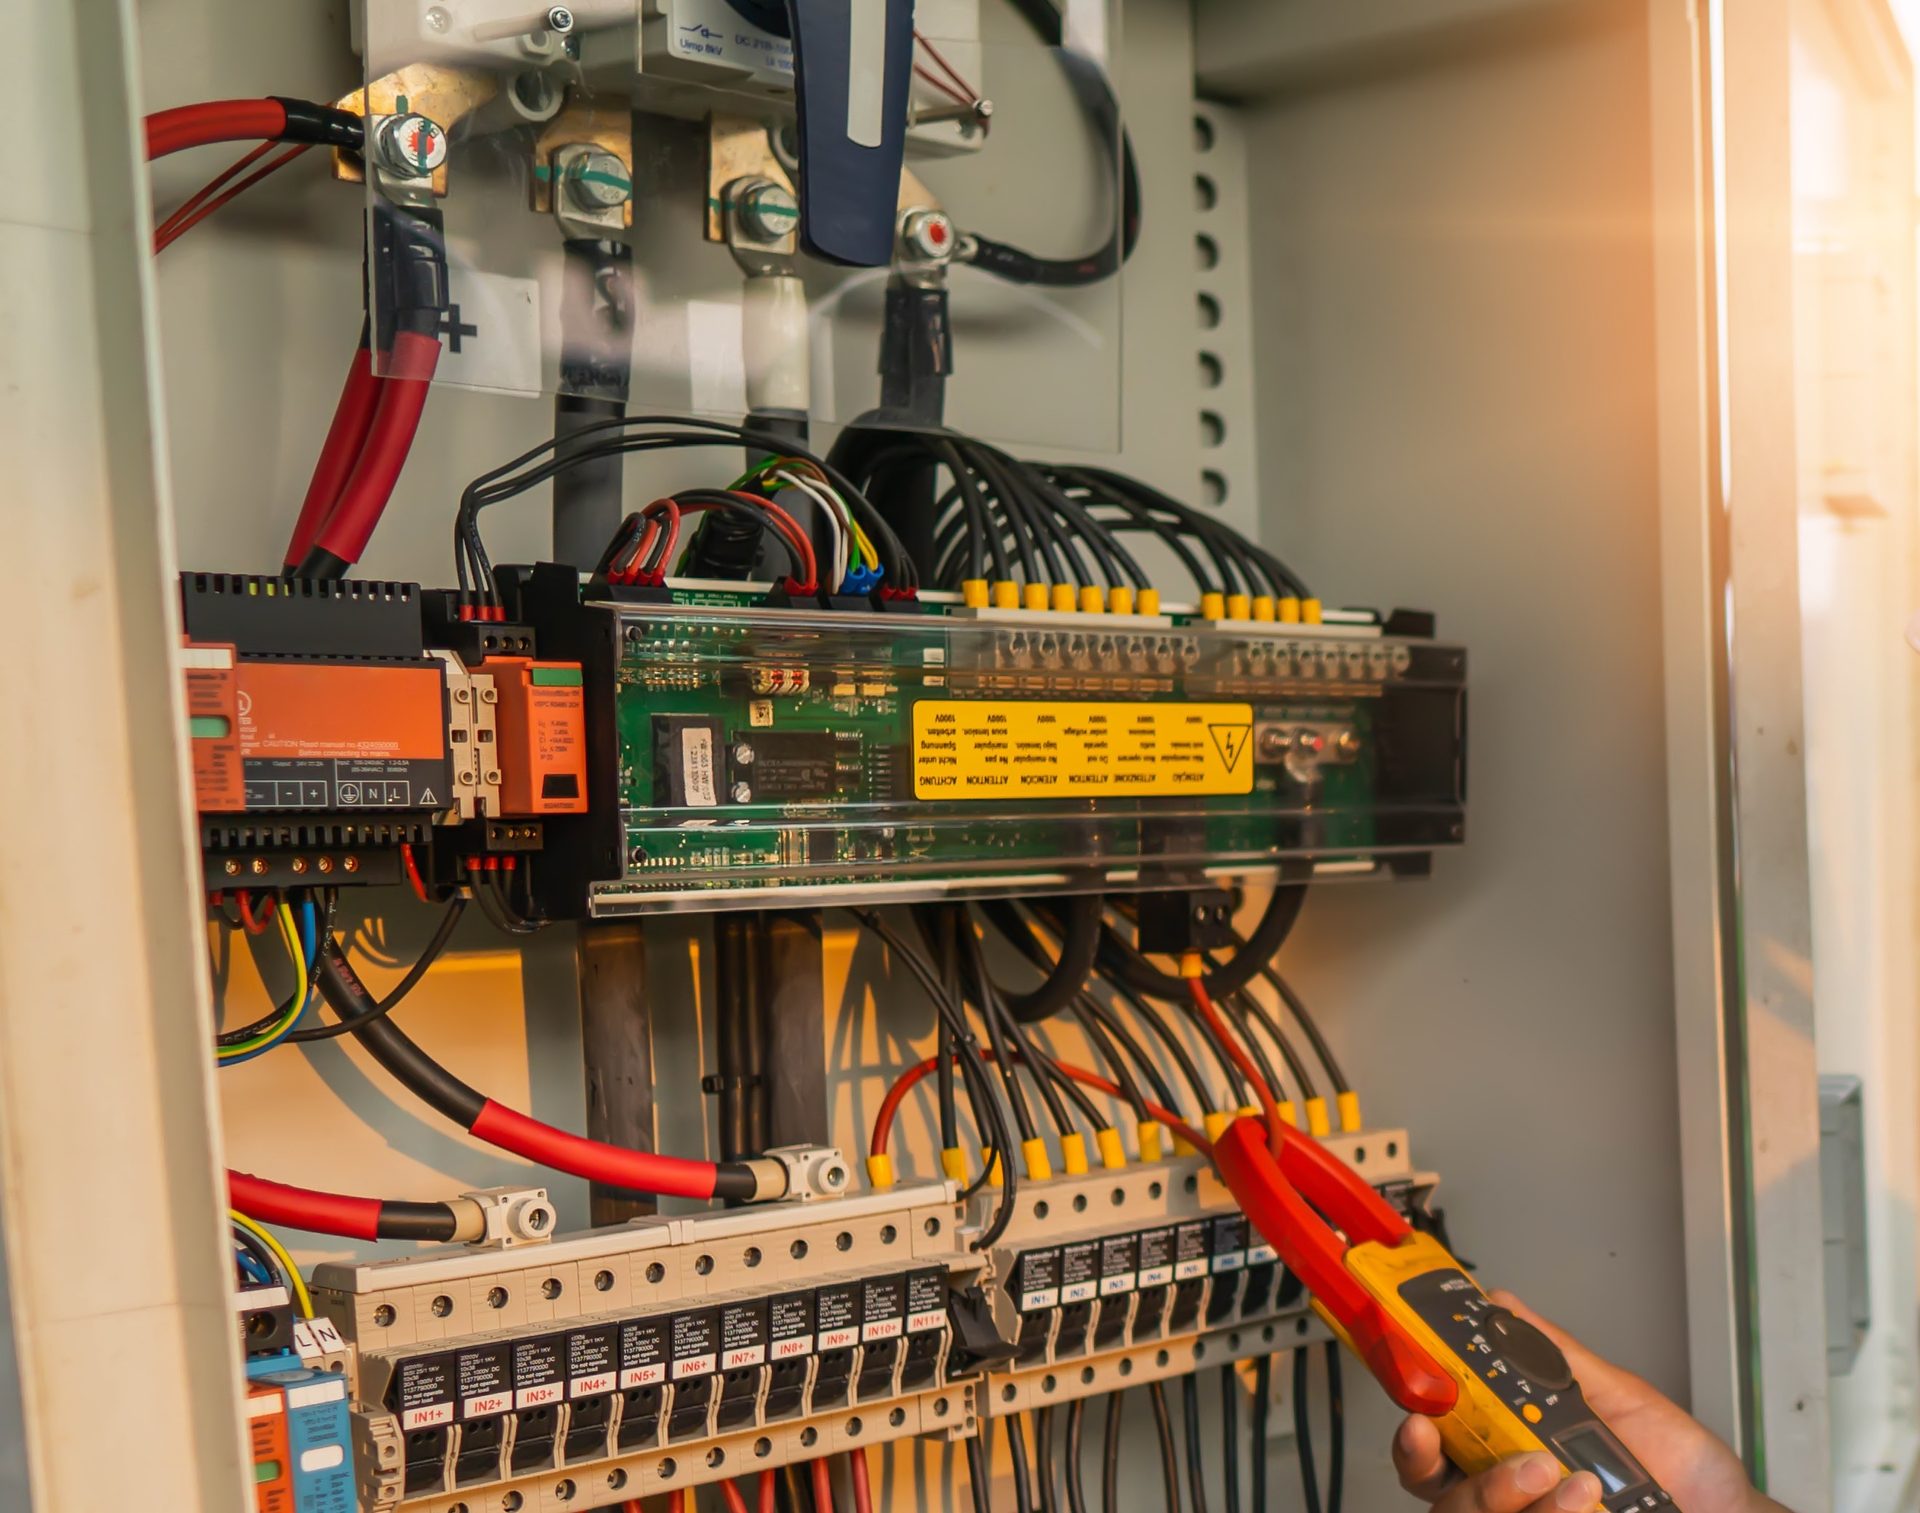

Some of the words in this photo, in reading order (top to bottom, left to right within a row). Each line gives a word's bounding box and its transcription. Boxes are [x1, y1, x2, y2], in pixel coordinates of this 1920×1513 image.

[935, 714, 955, 722] 1000V
[987, 714, 1006, 722] 1000V
[921, 741, 956, 750] Spannung
[974, 741, 1008, 750] manipuler
[939, 757, 957, 765] Nicht
[1014, 756, 1046, 764] manipular
[920, 776, 957, 785] ACHTUNG
[967, 776, 1008, 785] ATTENTION
[1069, 775, 1108, 784] ATTENTION
[369, 789, 378, 798] N
[868, 1324, 896, 1337] IN10+
[296, 1334, 312, 1346] L
[318, 1327, 336, 1342] N
[827, 1333, 849, 1345] IN9+
[780, 1343, 804, 1355] IN8+
[589, 1359, 608, 1367] operate
[731, 1352, 756, 1365] IN7+
[682, 1360, 707, 1373] IN6+
[535, 1369, 555, 1377] operate
[630, 1370, 656, 1383] IN5+
[479, 1379, 500, 1387] operate
[580, 1379, 607, 1392] IN4+
[526, 1390, 554, 1403] IN3+
[474, 1399, 503, 1413] IN2+
[414, 1410, 443, 1424] IN1+
